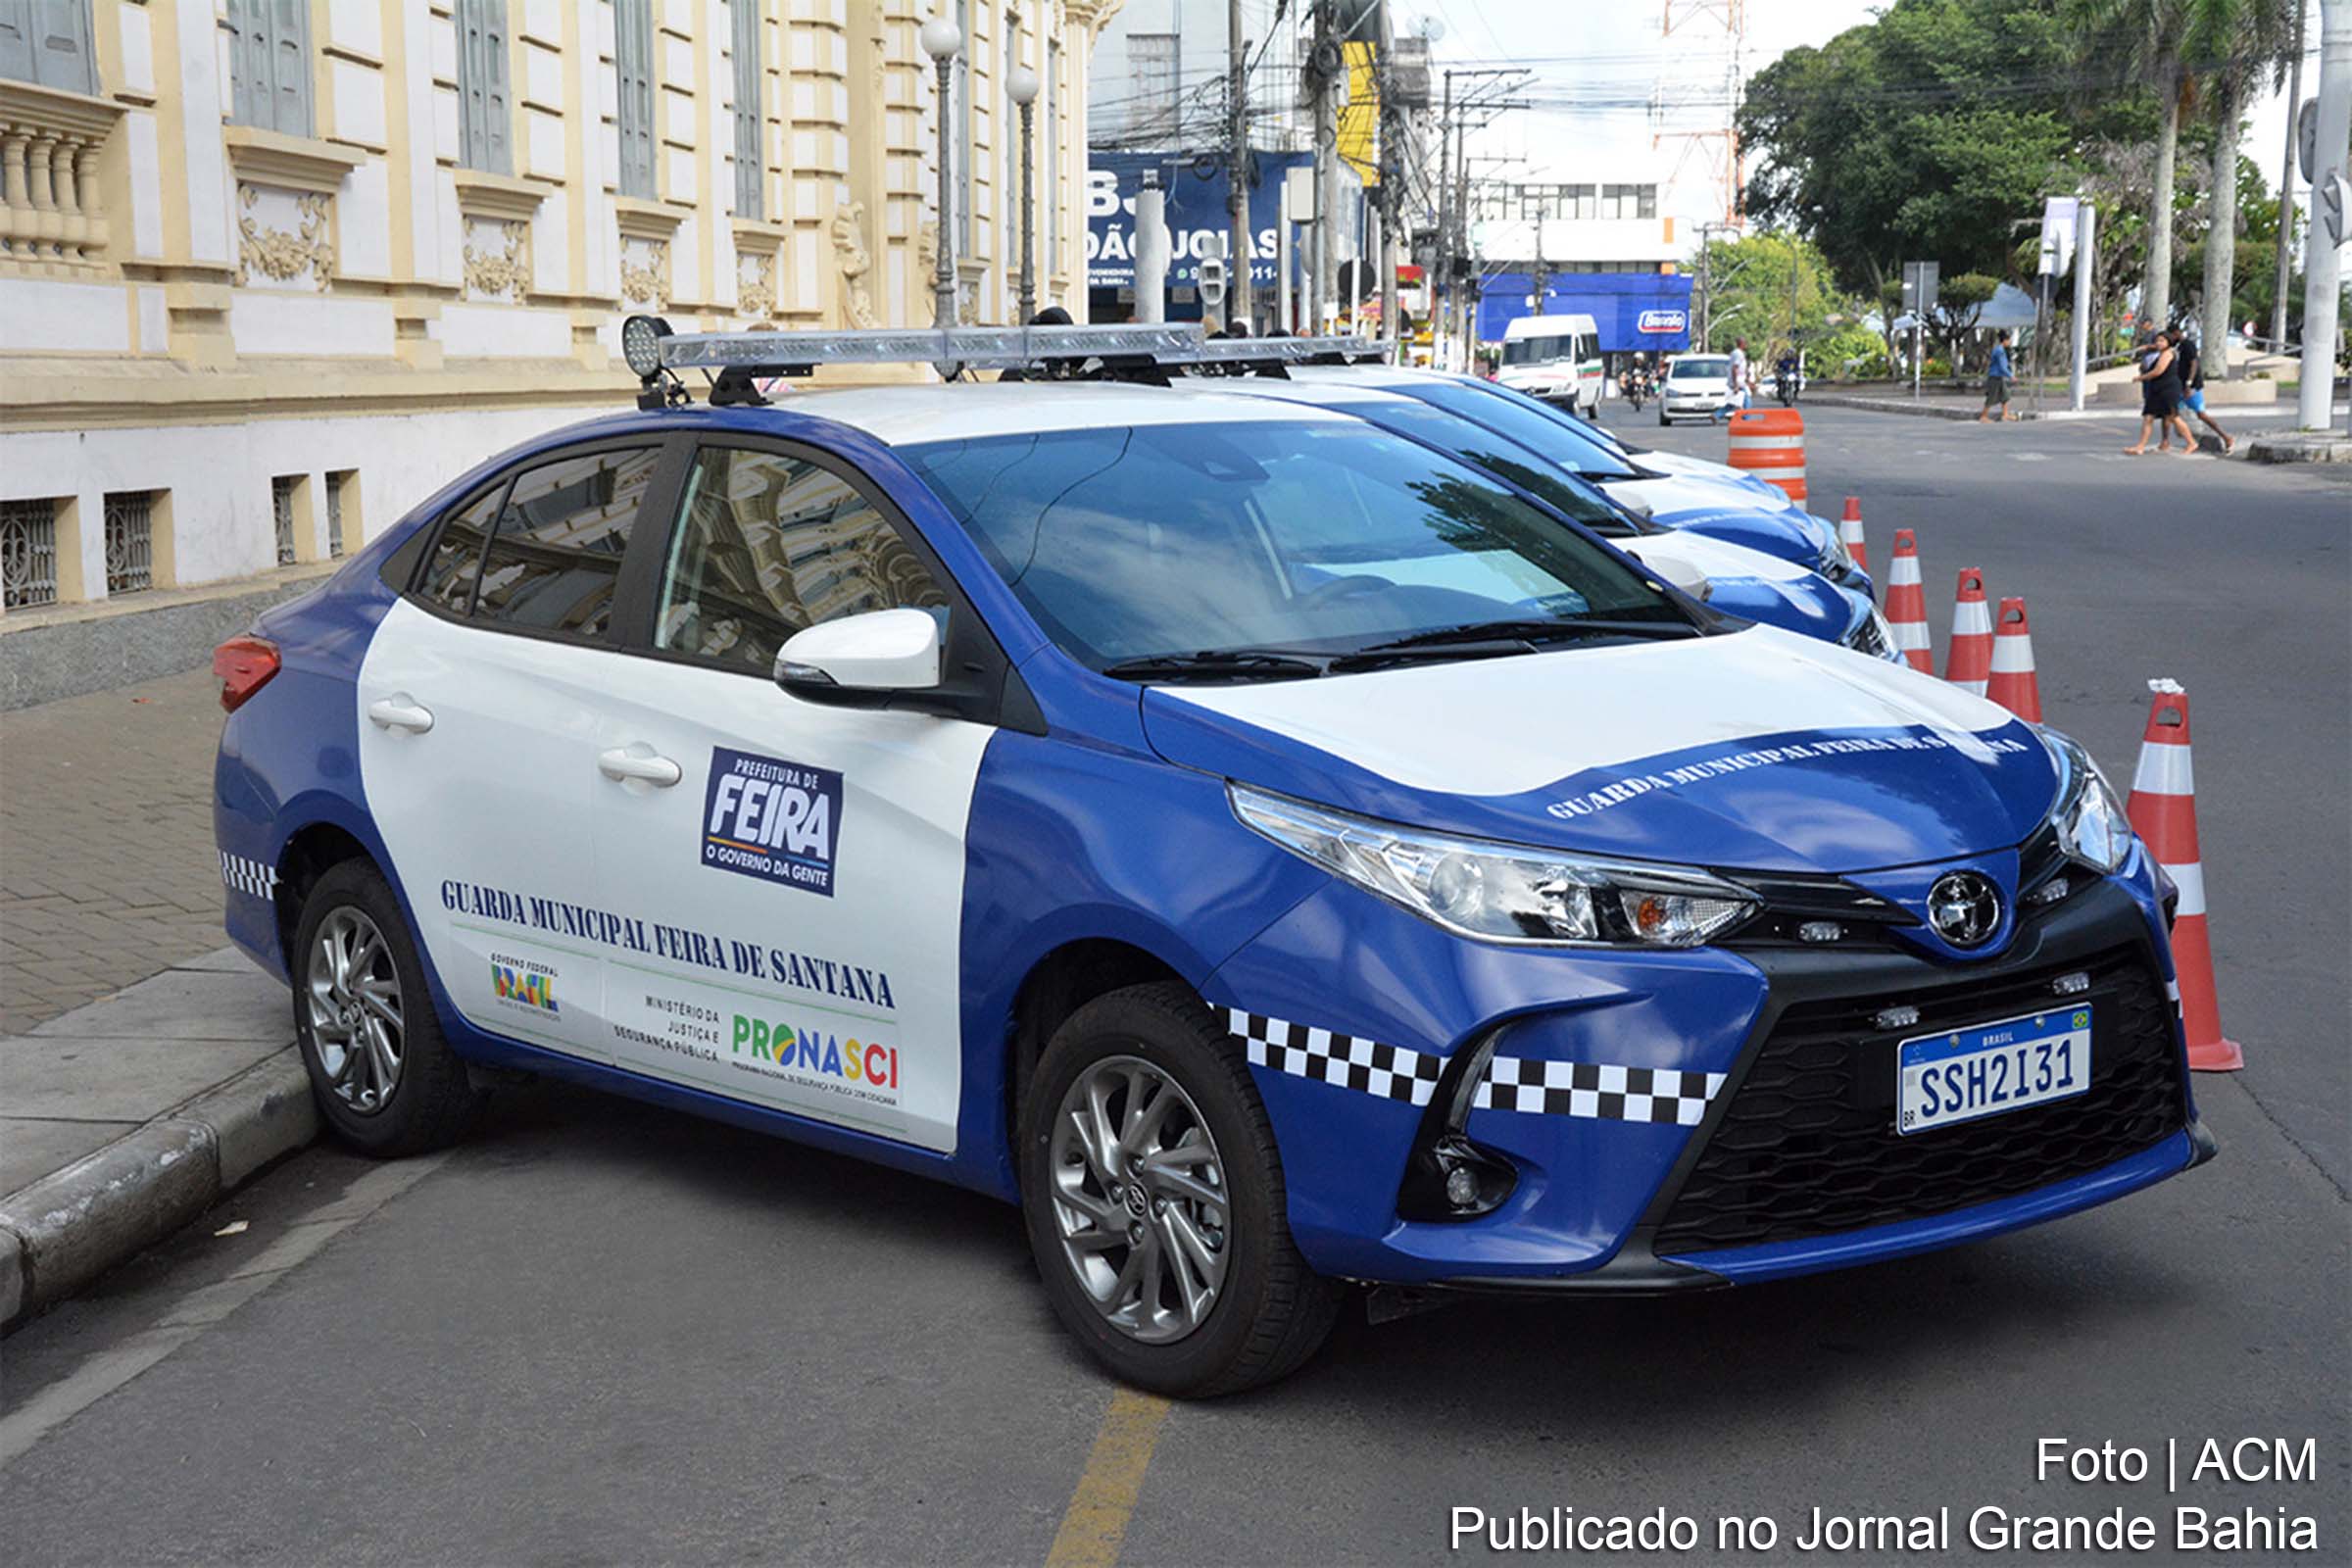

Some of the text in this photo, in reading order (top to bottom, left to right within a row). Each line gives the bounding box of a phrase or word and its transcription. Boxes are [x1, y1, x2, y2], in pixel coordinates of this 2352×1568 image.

[734, 758, 818, 790] PREFEITURA DE
[1546, 775, 1673, 819] GUARDA
[1663, 744, 1821, 785] MUNICIPAL
[1810, 737, 1897, 756] FEIRA
[709, 772, 830, 860] FEIRA
[706, 844, 829, 887] O GOVERNO DA GENTE
[441, 878, 896, 1009] GUARDA MUNICIPAL FEIRA DE SANTANA
[491, 963, 560, 1013] BRASIL
[645, 995, 720, 1024] MINISTÉRIO DA
[612, 1024, 673, 1052] SEGURANÇA
[666, 1020, 720, 1045] JUSTIÇA E
[732, 1013, 899, 1090] PRONASCI
[1982, 1030, 2014, 1048] BRASIL
[1920, 1039, 2074, 1118] SSH2I31
